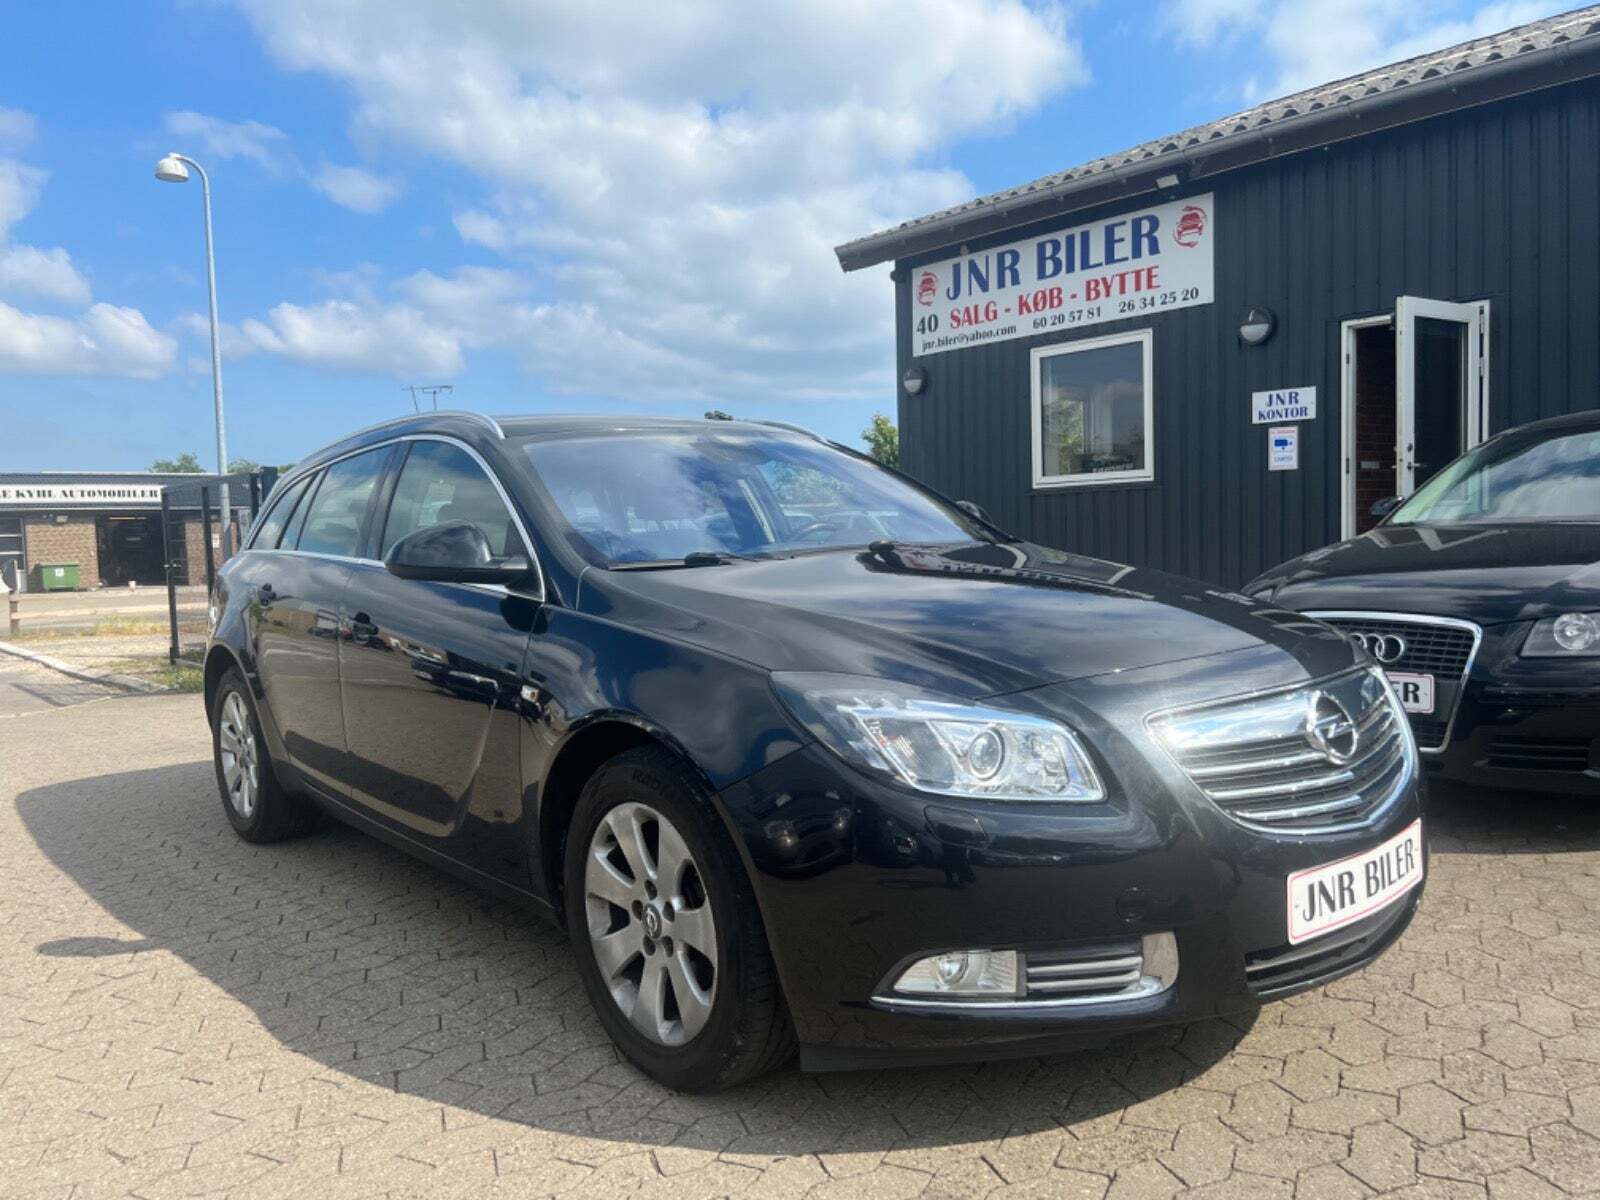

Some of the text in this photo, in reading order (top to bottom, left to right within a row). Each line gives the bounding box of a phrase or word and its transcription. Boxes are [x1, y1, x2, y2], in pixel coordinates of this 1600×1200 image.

[946, 214, 1161, 300] JNR BILER
[950, 300, 998, 330] SALG
[1018, 286, 1063, 316] KØB
[1085, 265, 1161, 302] BYTTE
[1118, 287, 1199, 313] 26 34 25 20
[916, 314, 939, 335] 40
[1032, 306, 1101, 329] 60 20 57 81
[922, 325, 1017, 352] jnr.biler@yahoo.com
[1265, 391, 1299, 407] JNR
[1258, 406, 1308, 420] KONTOR
[61, 488, 158, 498] AUTOMOBILER
[1303, 838, 1415, 922] JNR BILER
